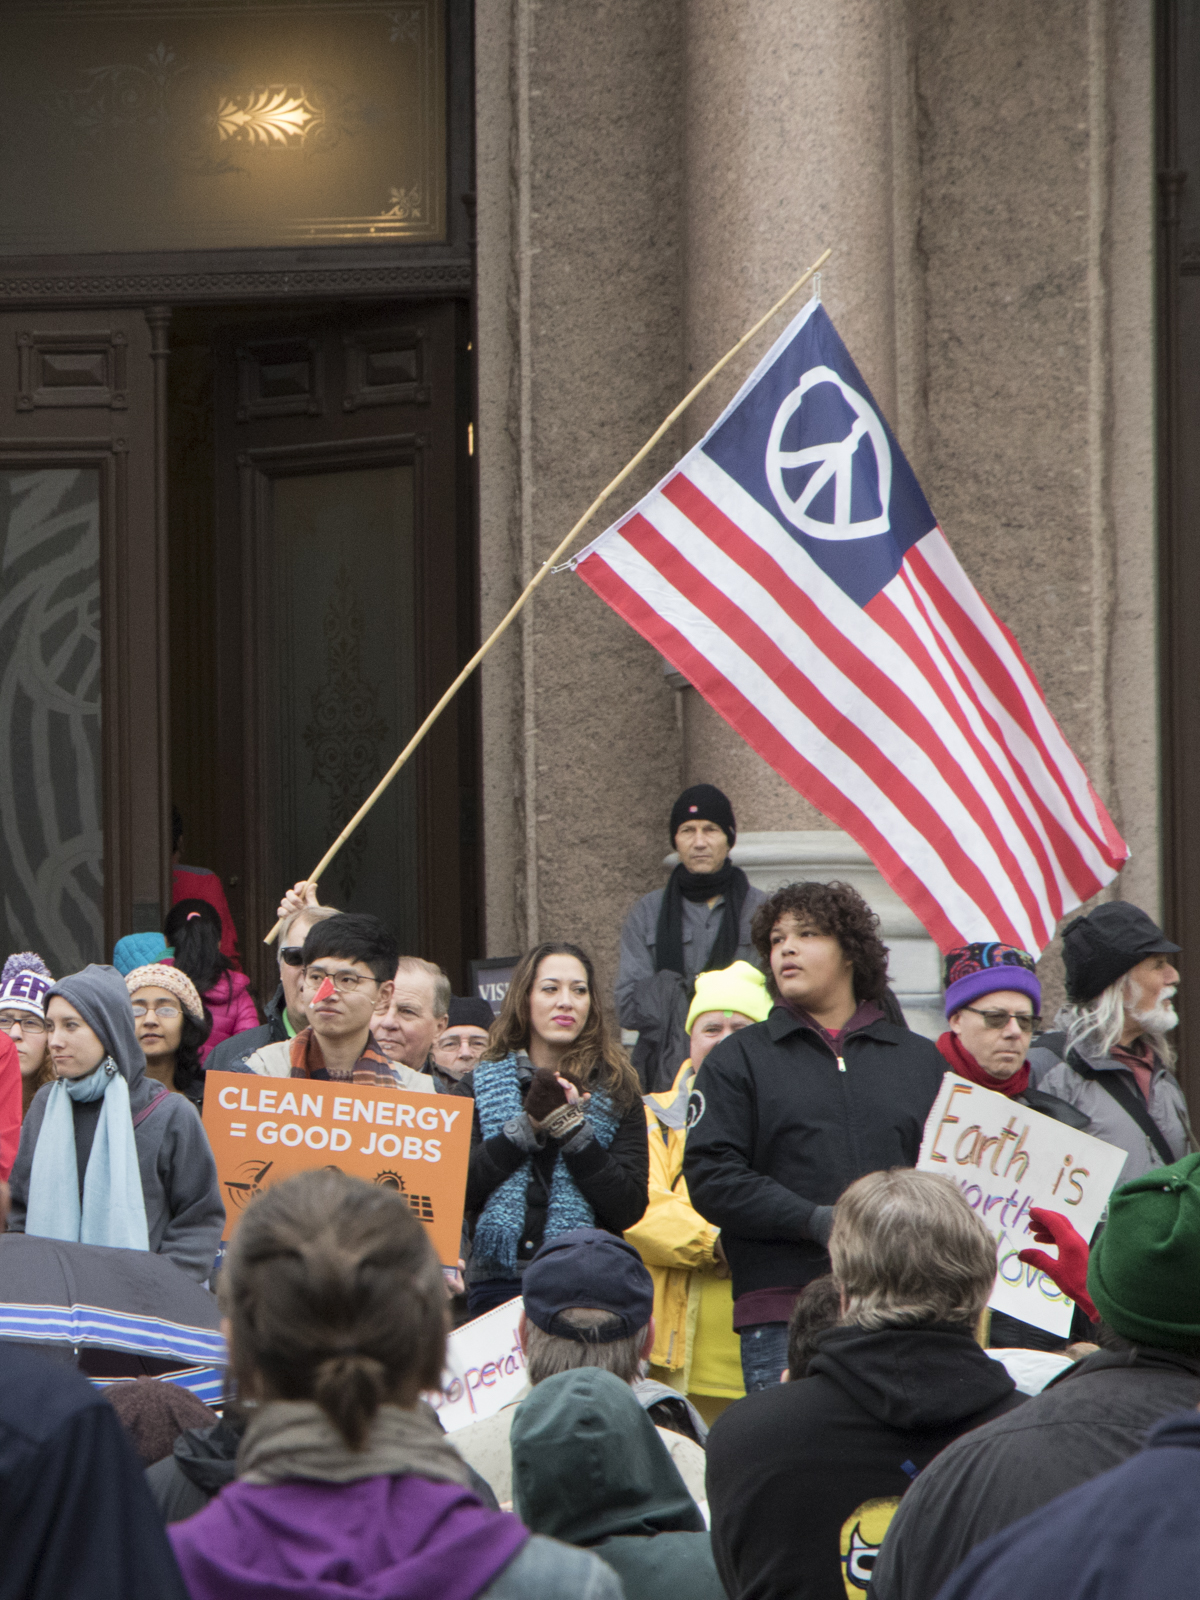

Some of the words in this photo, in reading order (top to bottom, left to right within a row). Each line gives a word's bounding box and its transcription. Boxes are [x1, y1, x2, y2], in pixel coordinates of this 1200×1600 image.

[478, 982, 510, 1001] VIS
[218, 1087, 324, 1118] CLEAN
[333, 1097, 461, 1133] ENERGY
[256, 1121, 352, 1152] GOOD
[360, 1132, 442, 1163] JOBS
[931, 1083, 1030, 1183] Earth
[1052, 1154, 1090, 1206] is
[960, 1180, 1035, 1235] orth
